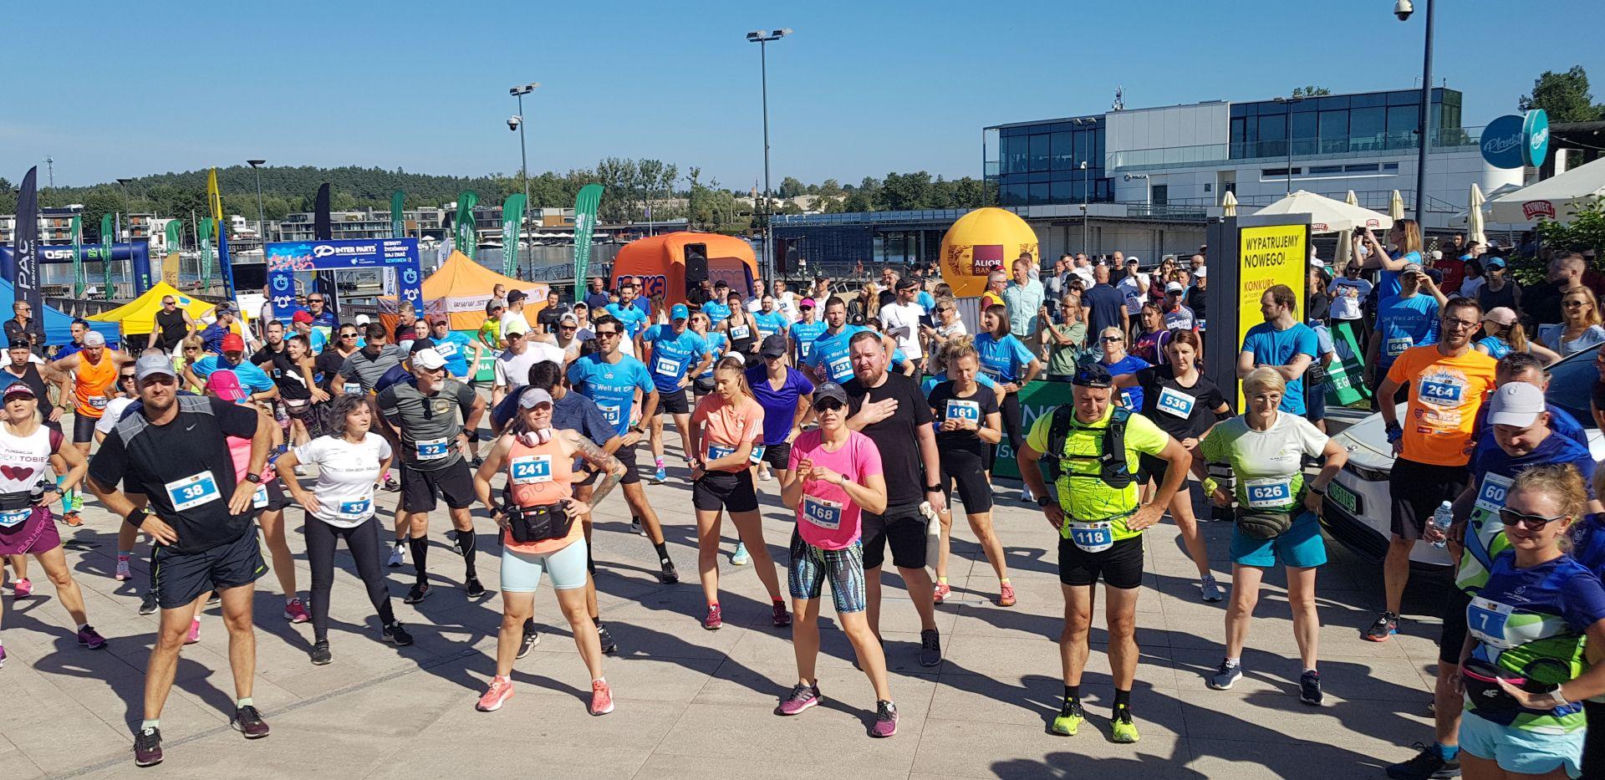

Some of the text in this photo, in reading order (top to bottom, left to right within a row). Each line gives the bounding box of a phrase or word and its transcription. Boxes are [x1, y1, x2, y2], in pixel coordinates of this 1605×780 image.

[1246, 235, 1299, 250] WYPATRUJEMY
[1245, 252, 1286, 268] NOWEGO!
[18, 240, 32, 302] -PAC
[1244, 279, 1275, 292] KONKURS
[597, 383, 612, 391] Well
[1427, 385, 1454, 398] 264
[1164, 395, 1187, 411] 536
[953, 407, 972, 418] 161
[425, 445, 440, 454] 32
[518, 463, 543, 476] 241
[182, 484, 205, 499] 38
[1254, 486, 1283, 498] 626
[1485, 485, 1505, 502] 60
[350, 503, 364, 513] 33
[811, 504, 834, 520] 168
[1077, 532, 1105, 544] 118
[1480, 613, 1489, 630] 7
[1482, 689, 1499, 698] 4F
